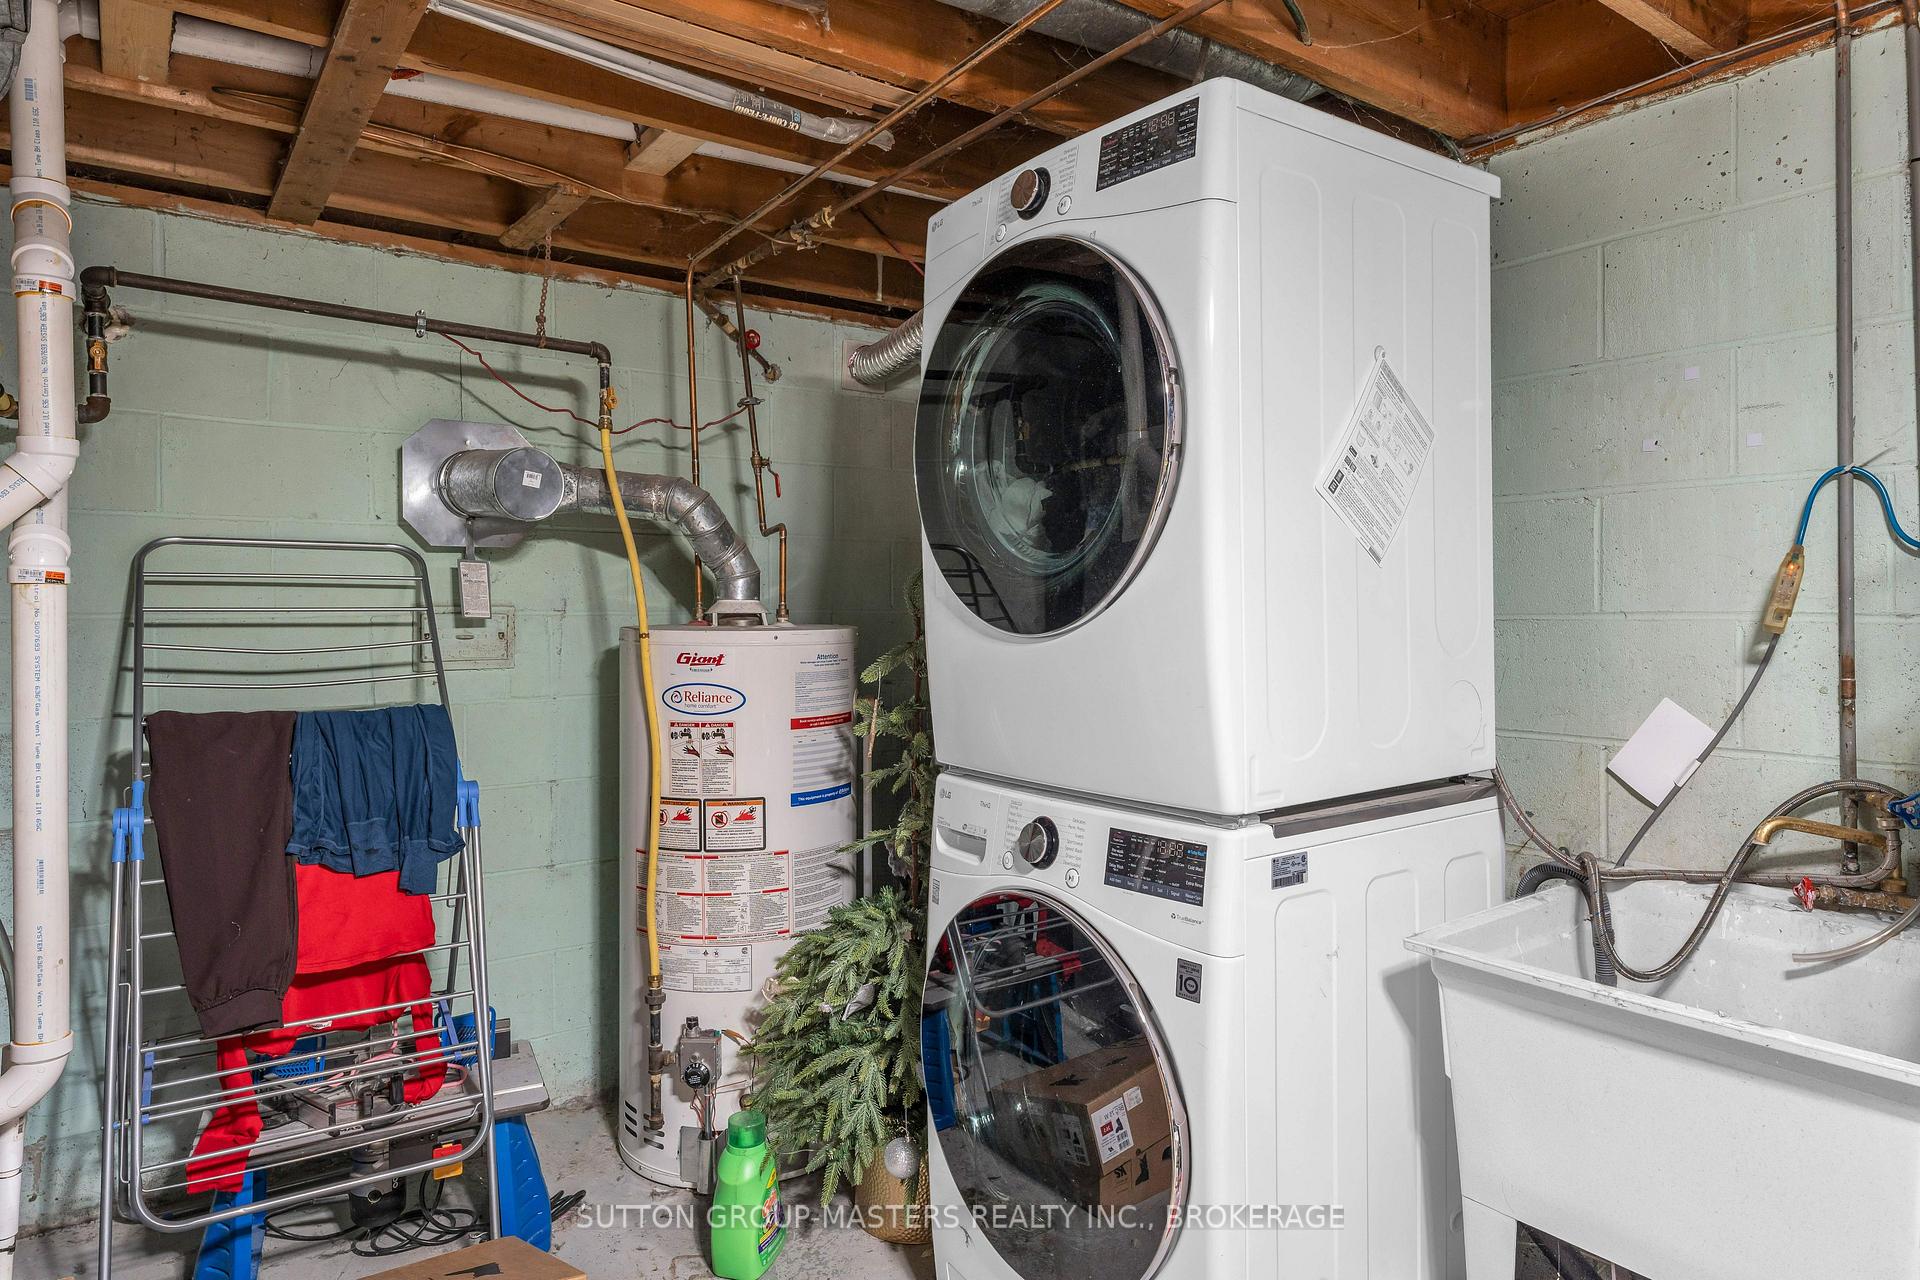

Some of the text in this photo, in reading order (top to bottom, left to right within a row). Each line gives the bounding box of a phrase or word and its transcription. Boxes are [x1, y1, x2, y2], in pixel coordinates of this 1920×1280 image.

[42, 410, 50, 421] ULC
[34, 608, 40, 618] No
[676, 652, 727, 667] Giant
[684, 690, 733, 703] Reliance
[944, 791, 952, 800] LG
[1179, 974, 1199, 995] 10
